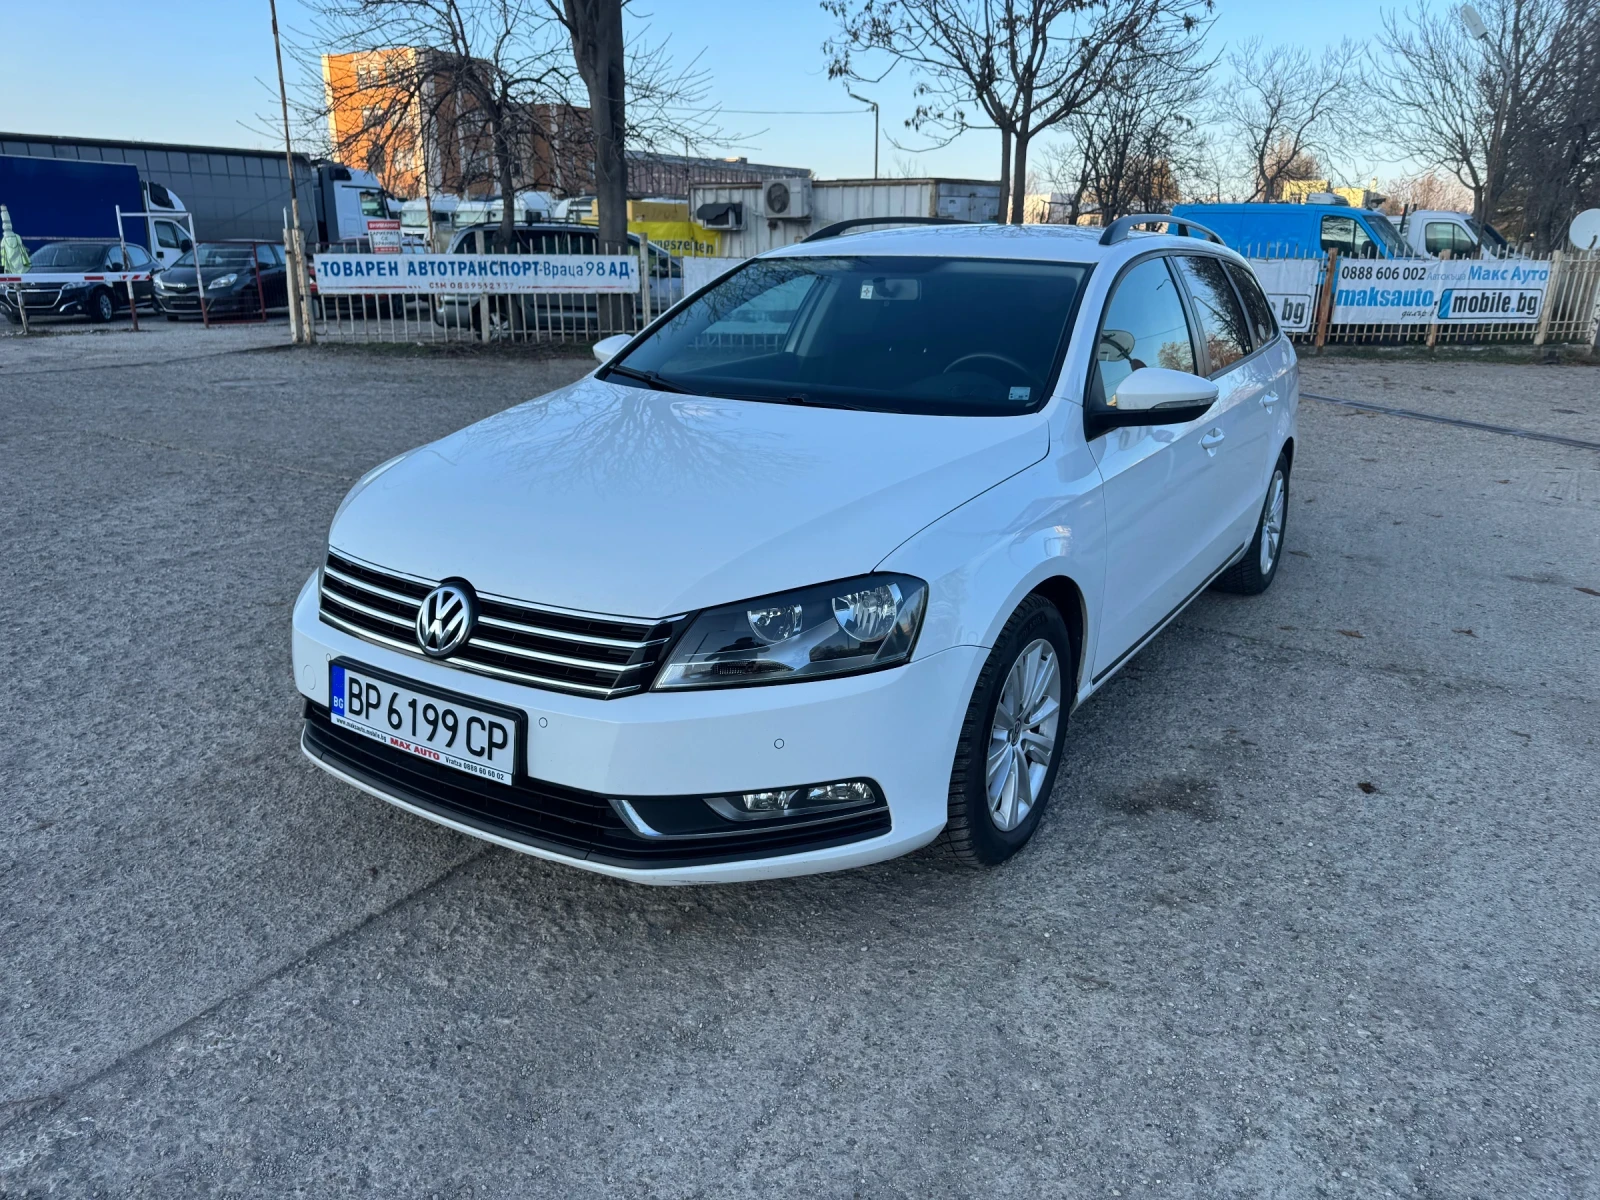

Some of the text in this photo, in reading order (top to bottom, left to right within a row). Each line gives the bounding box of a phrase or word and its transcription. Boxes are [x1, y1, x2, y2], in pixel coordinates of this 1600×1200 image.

[321, 261, 399, 277] ТОВАРЕН
[609, 261, 630, 279] АД
[1342, 266, 1373, 280] 0888
[1376, 266, 1400, 281] 606
[1403, 267, 1427, 281] 002
[1469, 265, 1508, 281] Макс
[1511, 266, 1548, 285] Ауто
[1452, 292, 1538, 315] mobile.bg
[333, 696, 344, 709] BG
[390, 737, 440, 761] MAX AUTO
[445, 756, 504, 781] Vratza 0888 60 60 02
